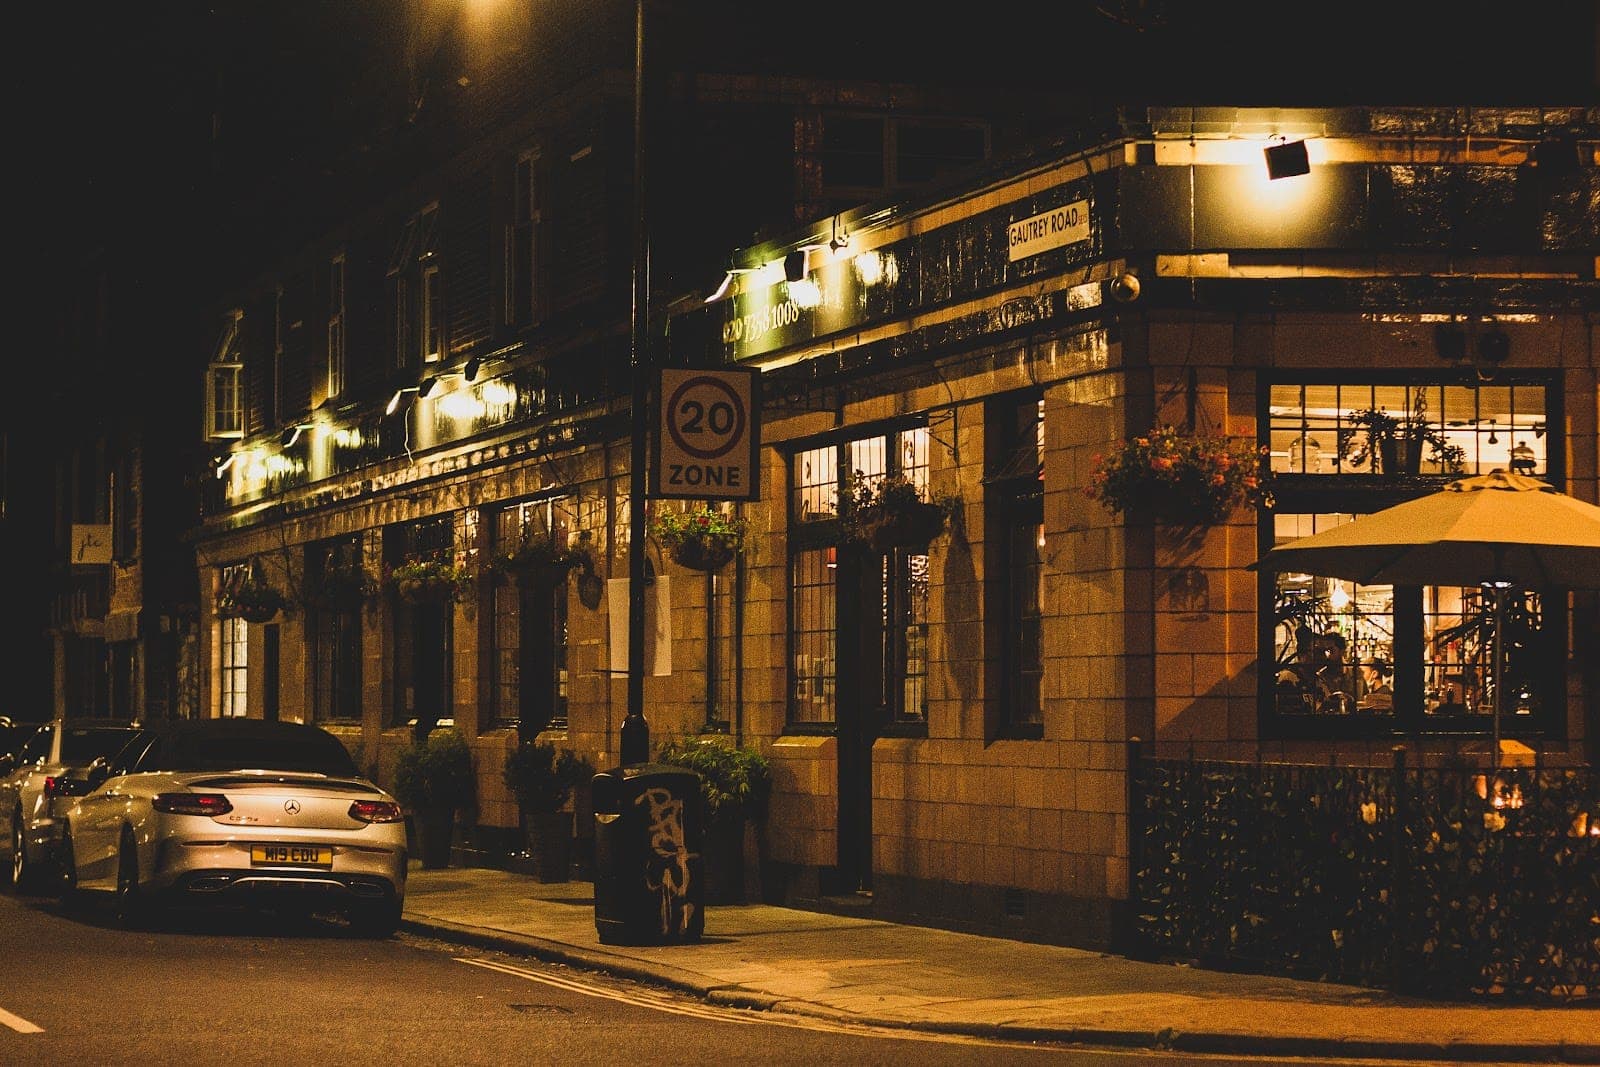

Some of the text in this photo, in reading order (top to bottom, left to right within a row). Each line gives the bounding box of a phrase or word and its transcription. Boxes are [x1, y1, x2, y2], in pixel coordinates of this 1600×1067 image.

[1010, 217, 1048, 246] GAUTREY
[1051, 208, 1078, 233] ROAD
[723, 318, 743, 344] 020
[771, 297, 799, 330] 1008
[681, 400, 734, 435] 20
[669, 465, 740, 486] ZONE
